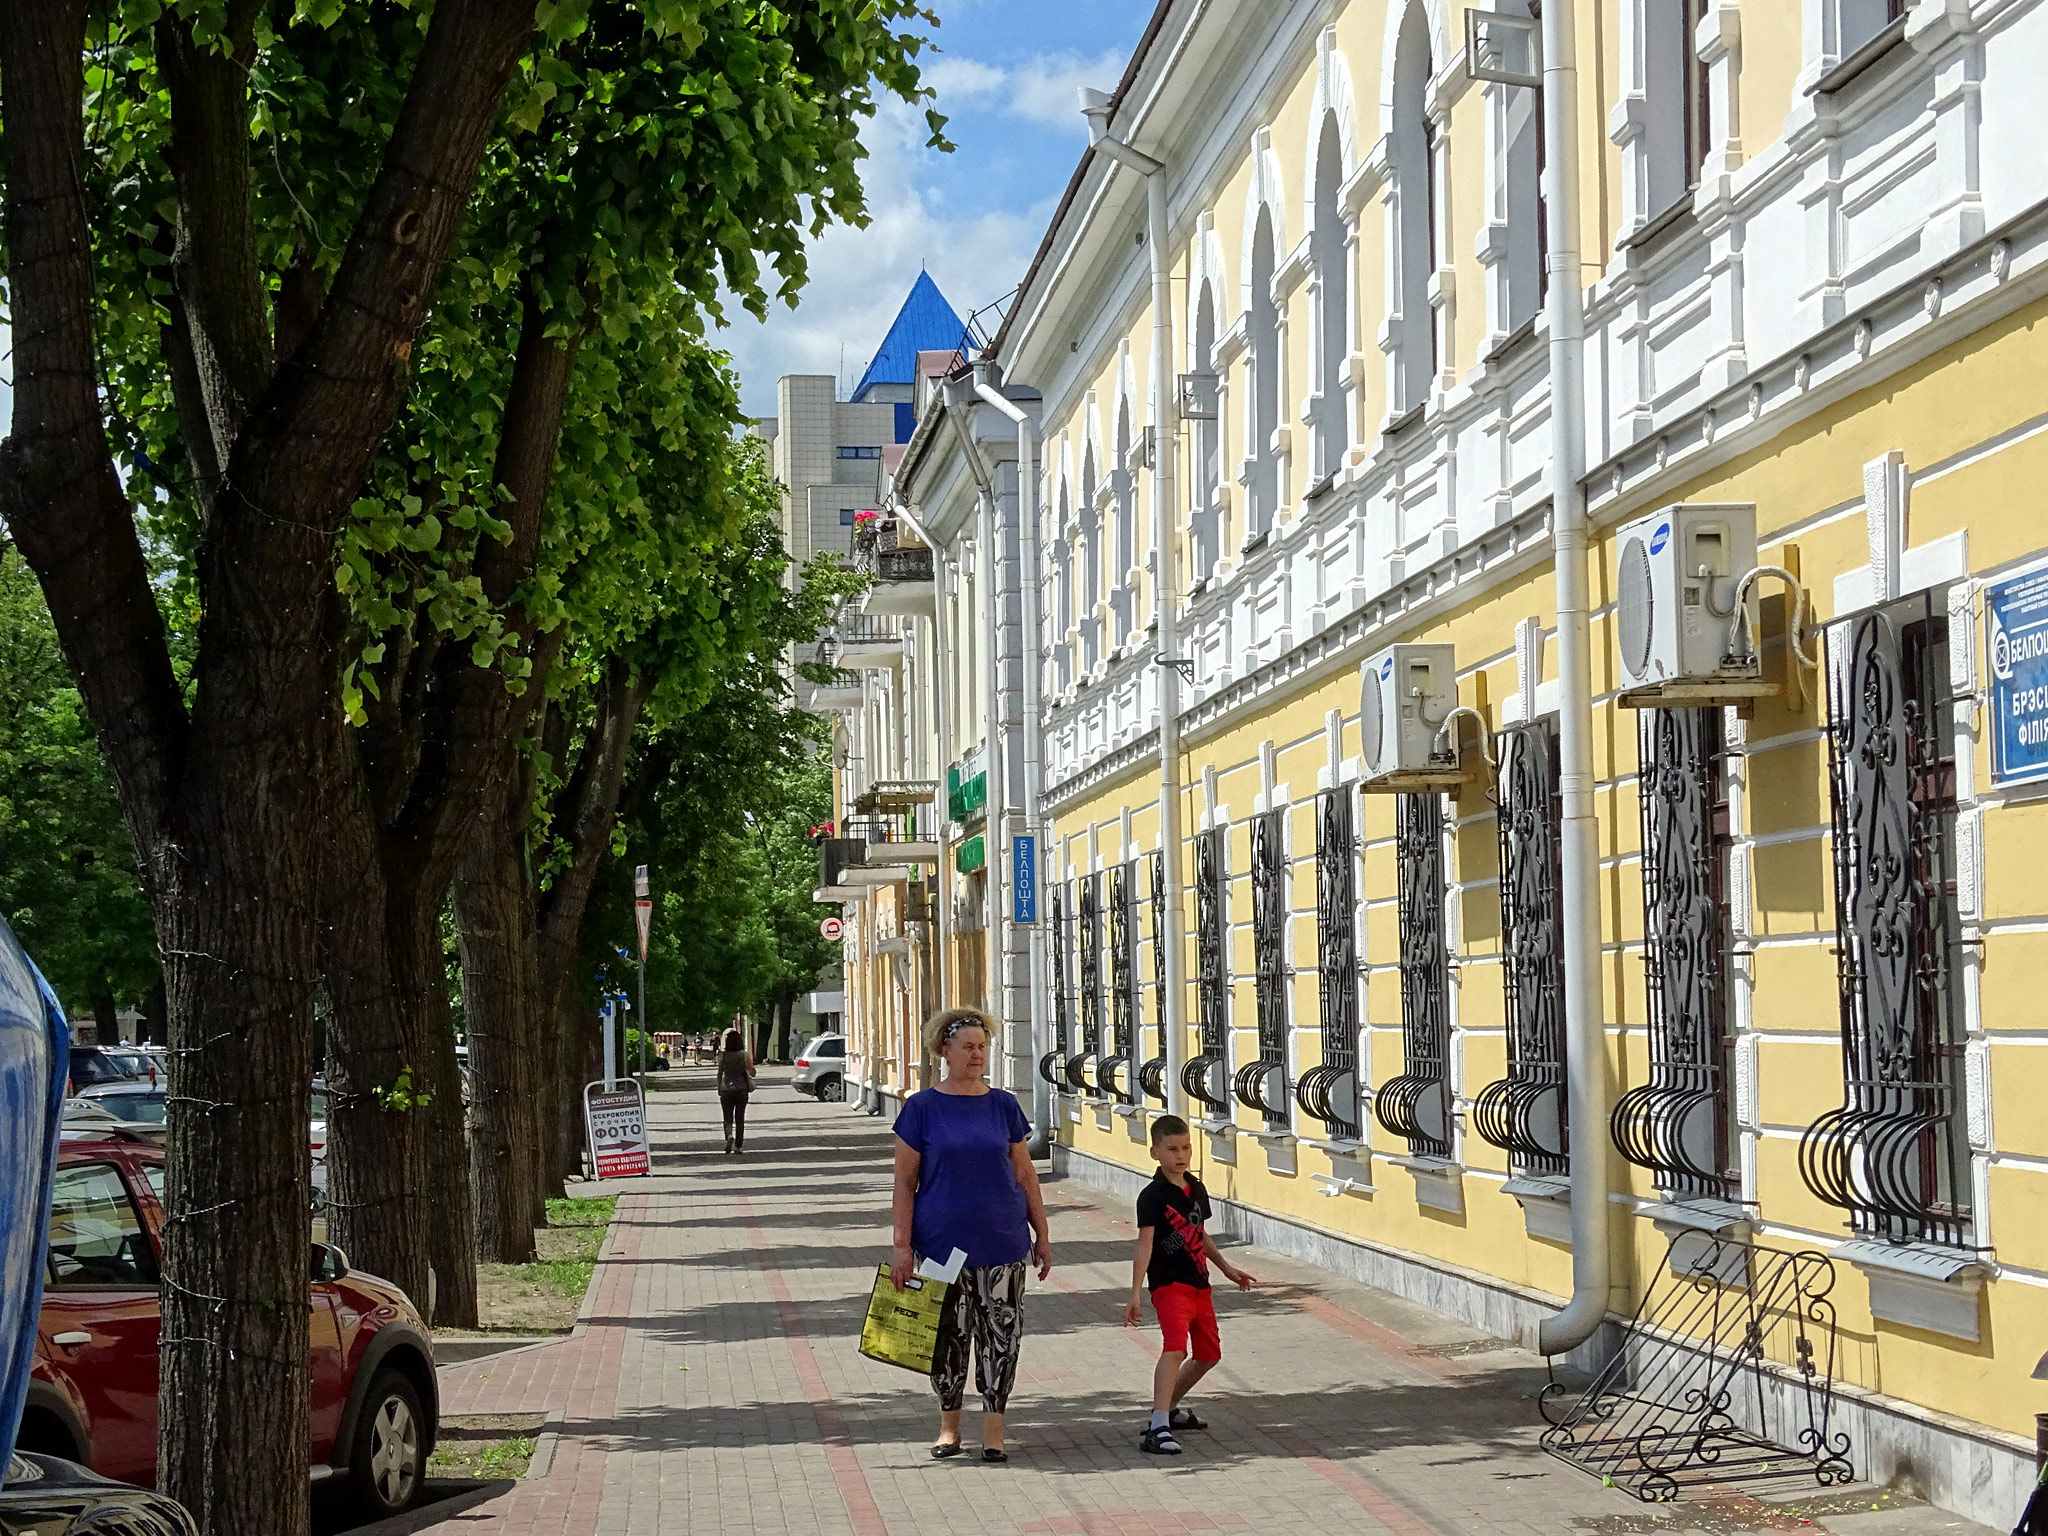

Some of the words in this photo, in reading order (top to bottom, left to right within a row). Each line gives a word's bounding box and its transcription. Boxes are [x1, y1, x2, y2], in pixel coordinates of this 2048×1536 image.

[1018, 840, 1031, 918] БЕЛПОШТА
[590, 1095, 638, 1105] ФОТОСТУДИЯ
[592, 1110, 640, 1120] КСЕРОКОПИЯ
[593, 1117, 640, 1126] СРОЧНОЕ
[595, 1124, 641, 1139] ФОТО
